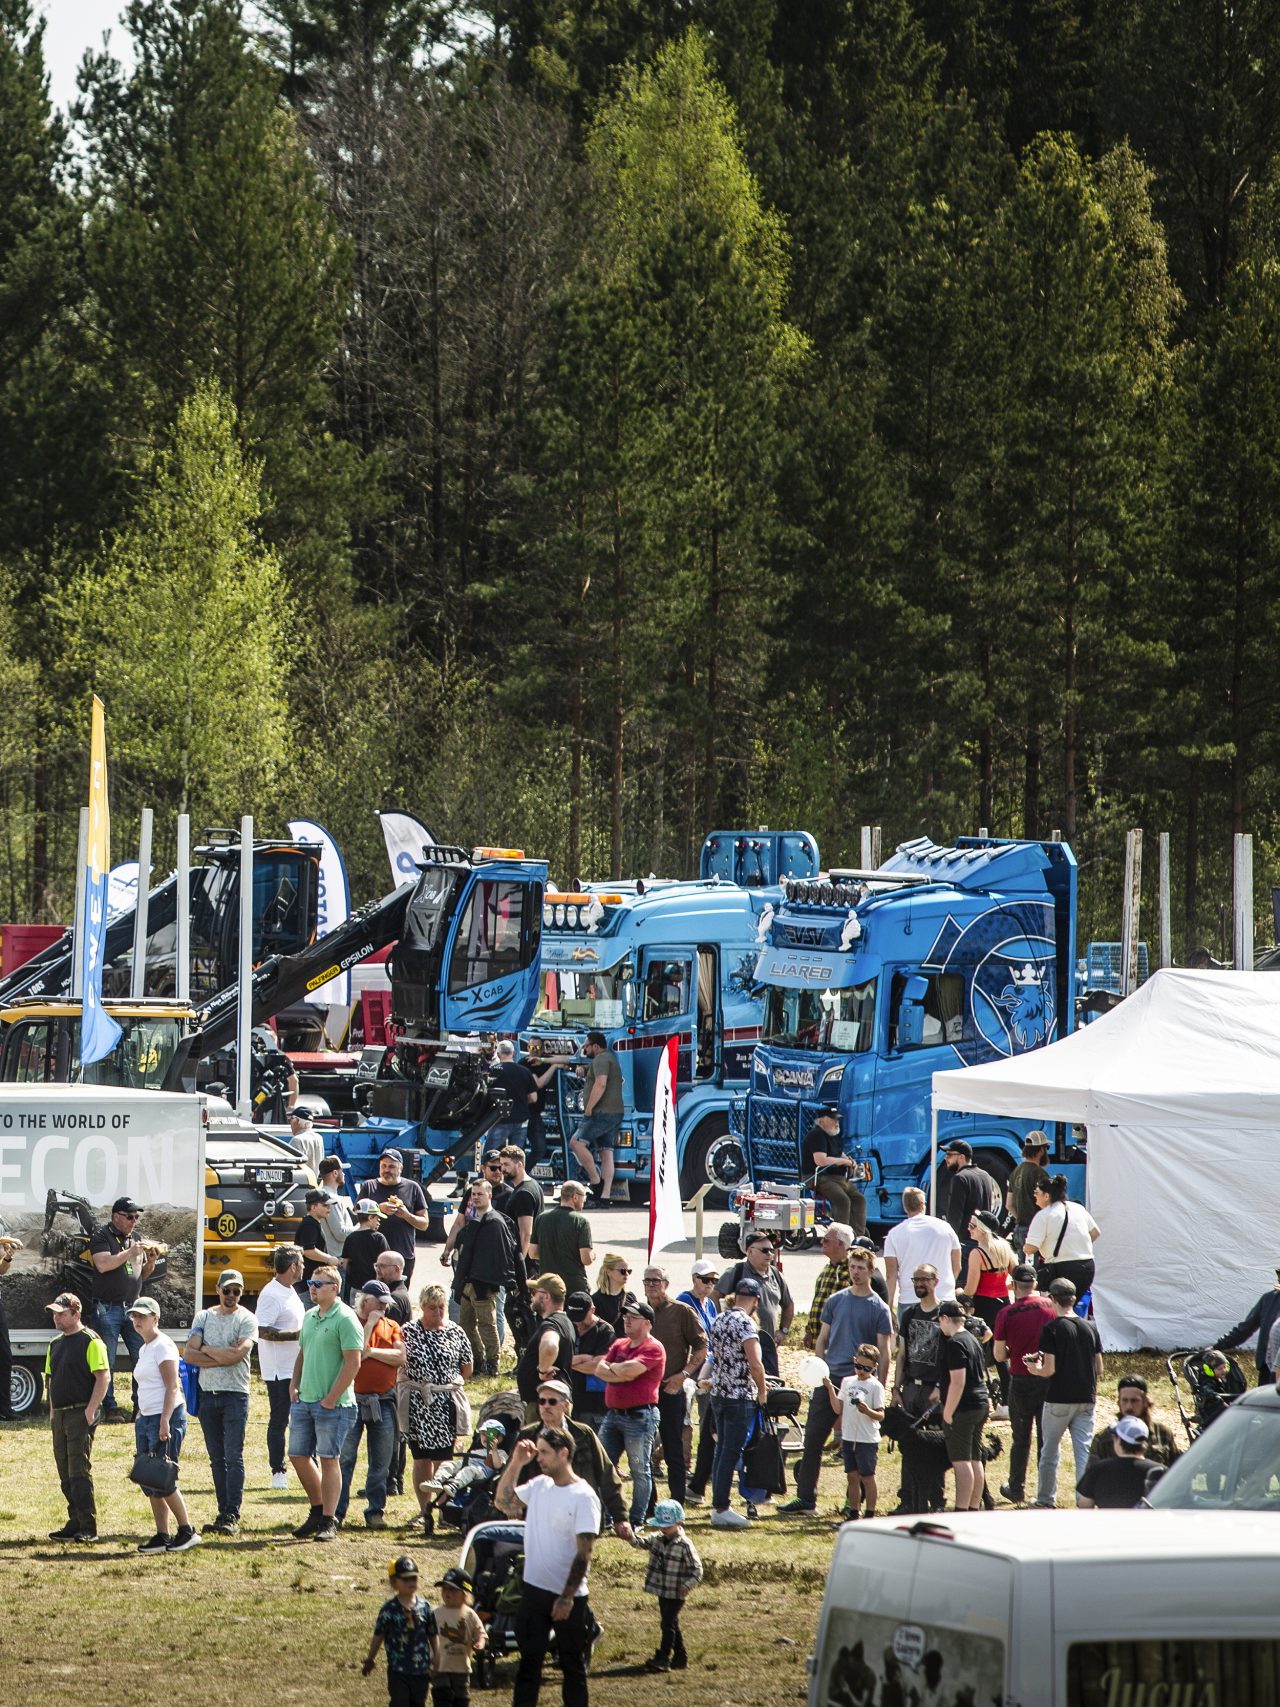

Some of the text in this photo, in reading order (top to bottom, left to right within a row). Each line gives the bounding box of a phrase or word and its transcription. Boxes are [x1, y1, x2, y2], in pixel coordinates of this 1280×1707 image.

[308, 943, 375, 989] PALFINGER EPSILON
[770, 962, 833, 984] LIARED
[27, 980, 46, 996] 108S
[471, 984, 503, 1005] X CAB
[543, 1039, 575, 1055] CANIA
[774, 1069, 815, 1087] SCANIA
[19, 1114, 47, 1128] THE
[52, 1114, 105, 1128] WORLD
[112, 1114, 130, 1128] OF
[220, 1218, 236, 1233] 50
